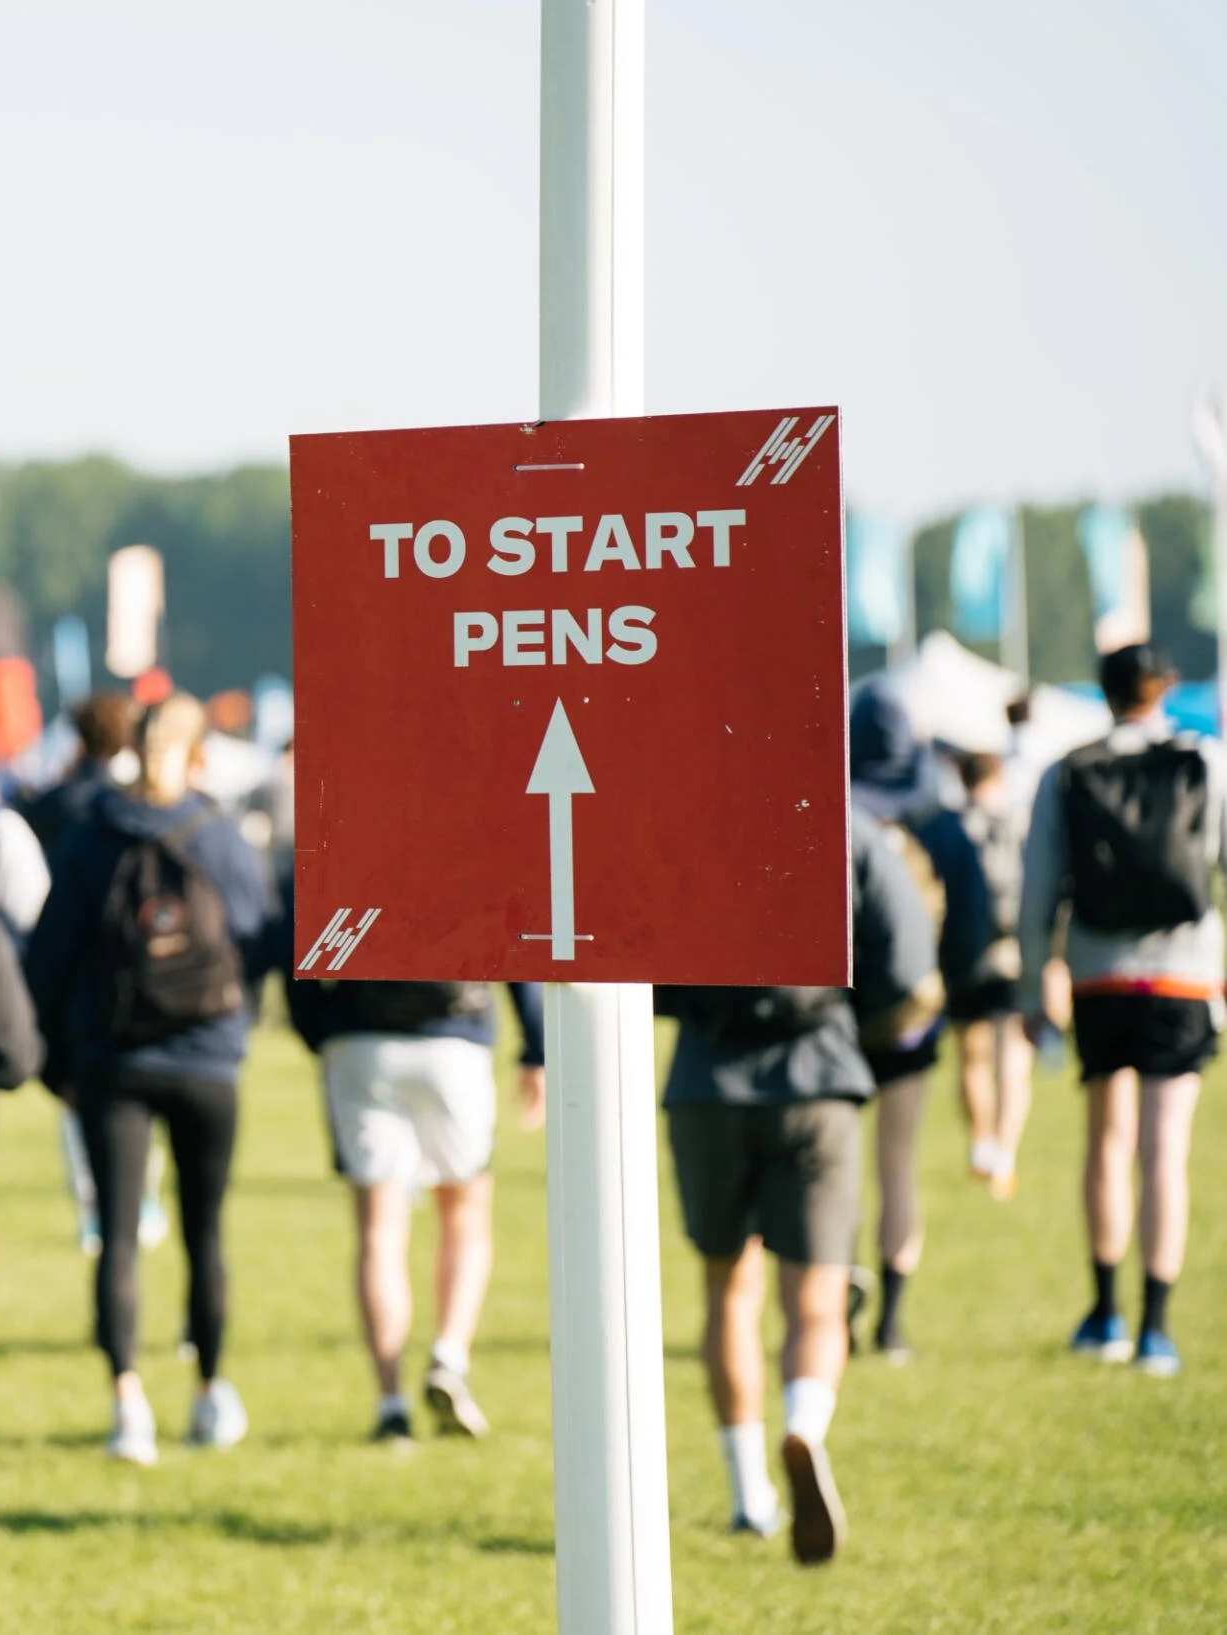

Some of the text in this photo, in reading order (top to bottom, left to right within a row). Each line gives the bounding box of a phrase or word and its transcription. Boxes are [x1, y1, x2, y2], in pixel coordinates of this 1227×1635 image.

[370, 509, 746, 578] TO START
[454, 605, 657, 667] PENS
